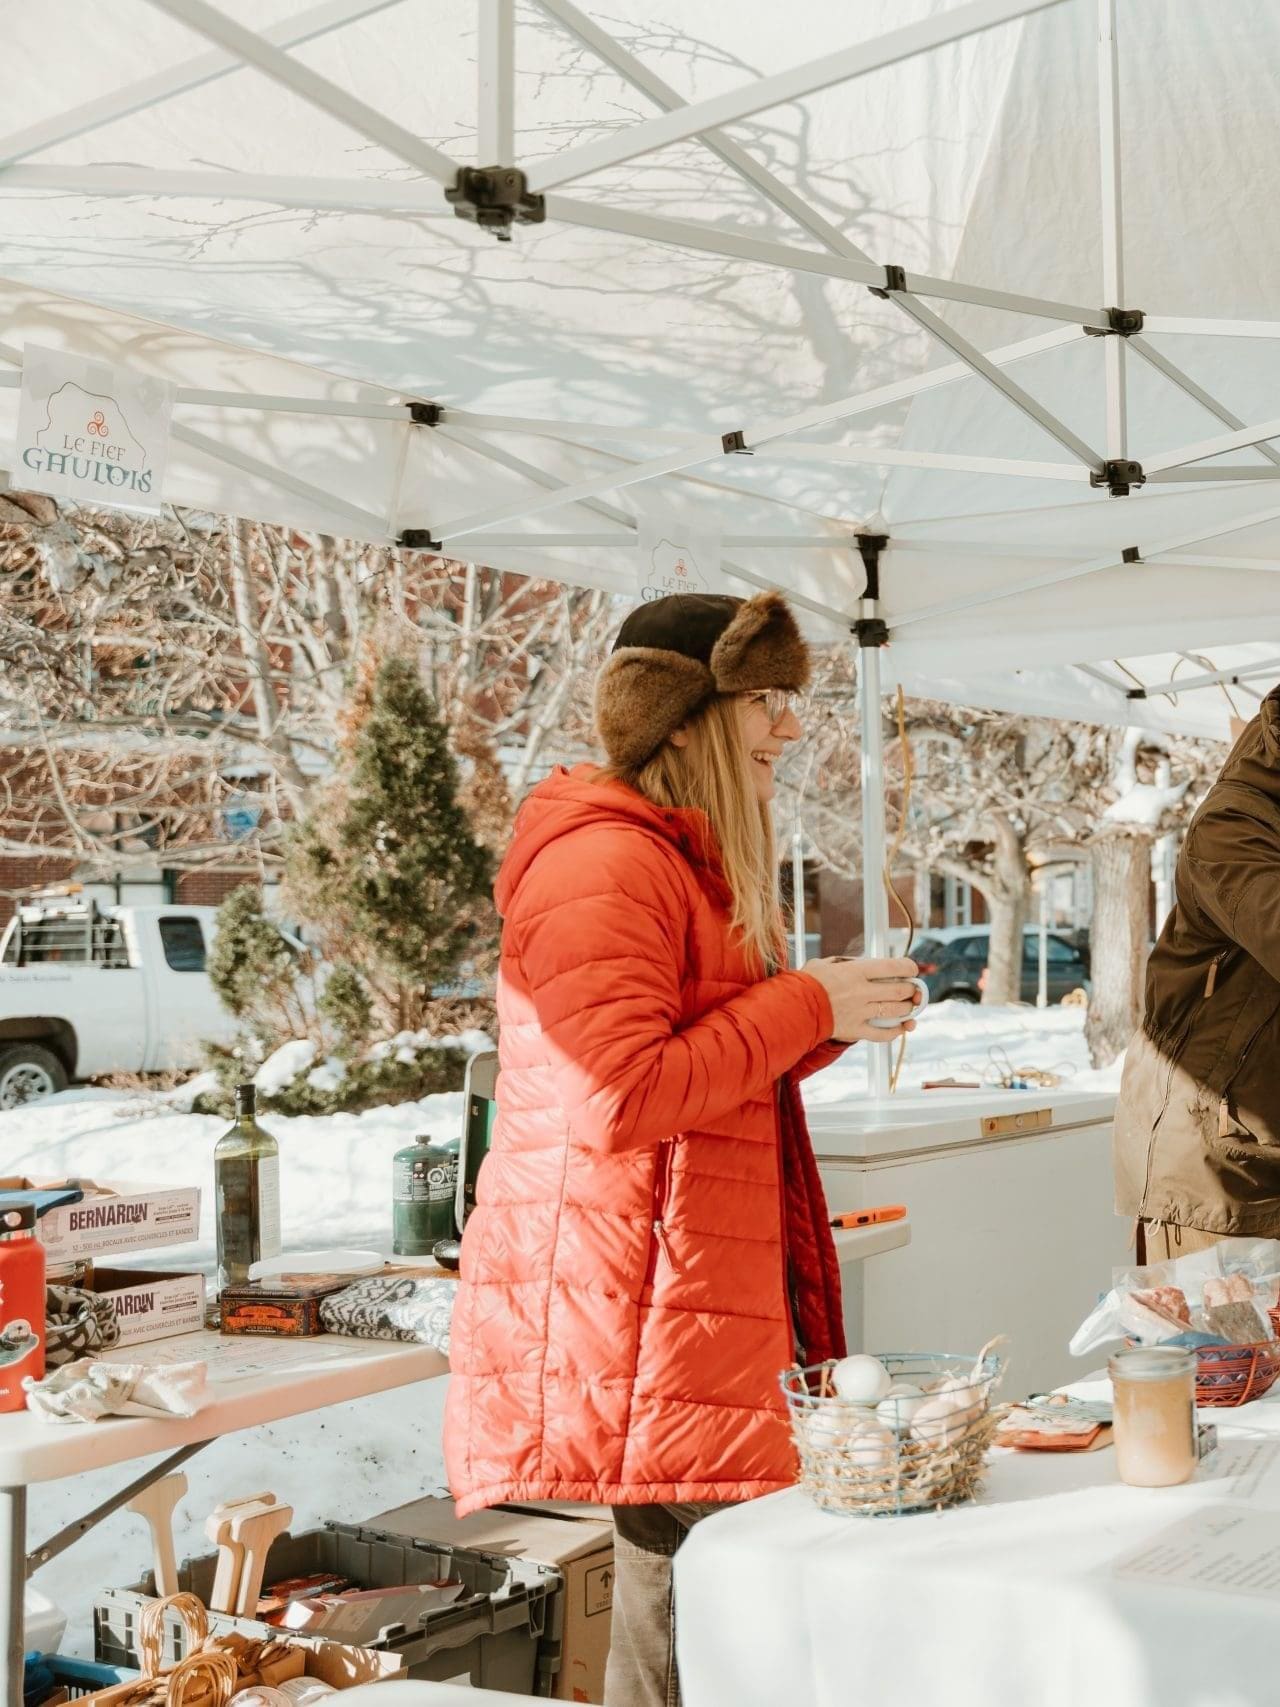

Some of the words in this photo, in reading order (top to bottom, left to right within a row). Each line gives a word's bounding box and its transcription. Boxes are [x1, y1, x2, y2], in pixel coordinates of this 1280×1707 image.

[63, 434, 86, 453] LE
[91, 441, 126, 462] FIEF
[22, 447, 153, 493] GAULOIS
[662, 575, 675, 588] LE
[69, 1202, 148, 1231] BERNARDIN
[111, 1291, 154, 1316] ARDIN
